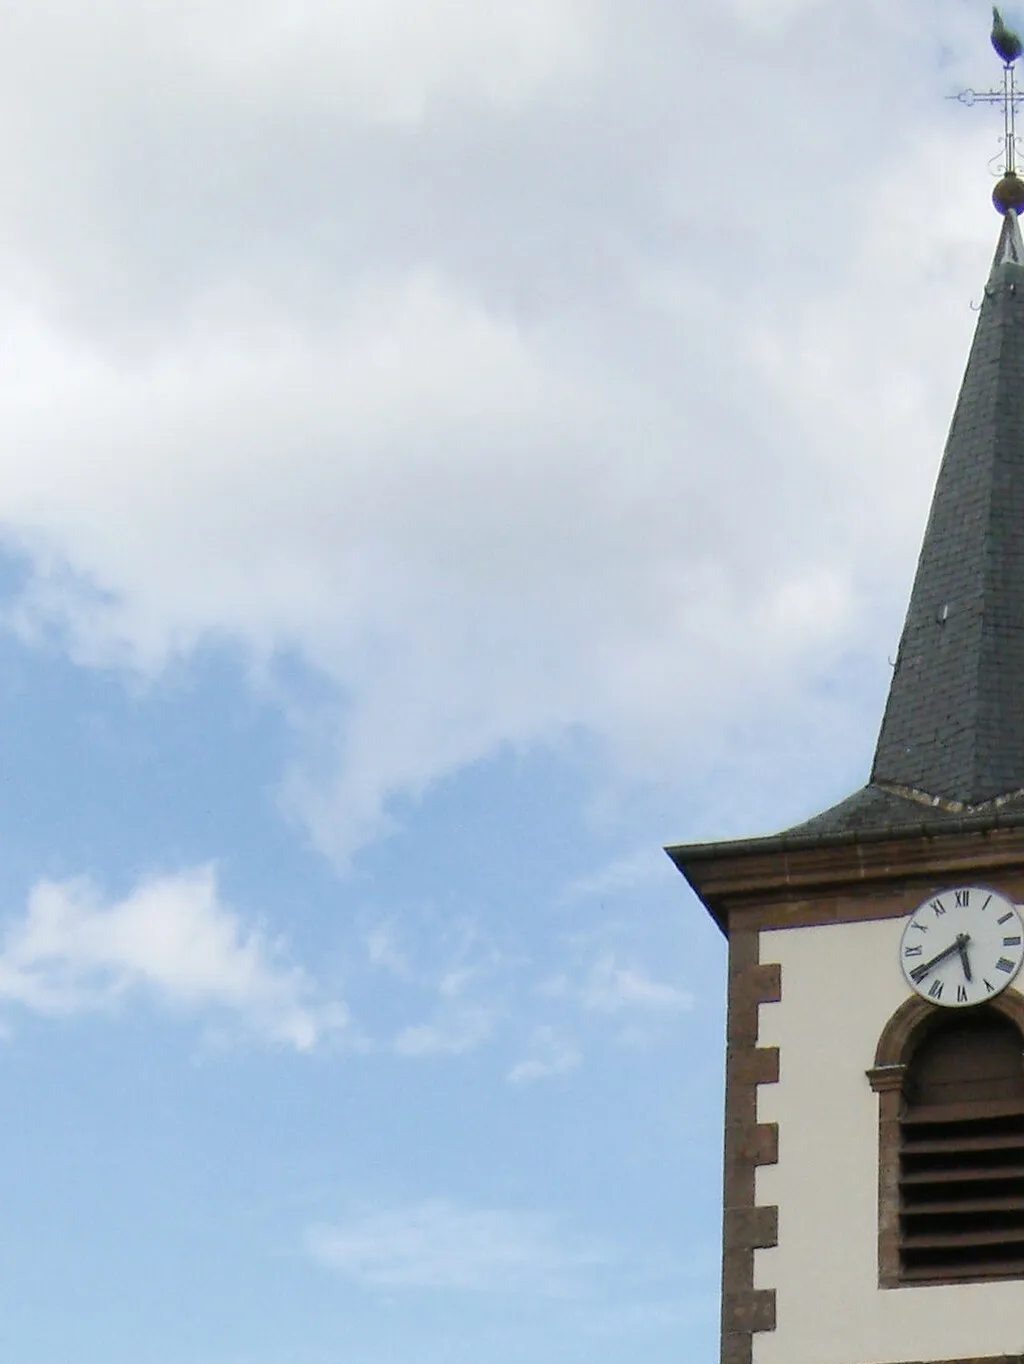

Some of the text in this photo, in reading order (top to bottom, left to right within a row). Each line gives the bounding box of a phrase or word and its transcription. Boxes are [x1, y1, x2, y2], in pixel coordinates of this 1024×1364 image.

[929, 897, 946, 918] XI
[955, 890, 969, 908] XII
[911, 920, 928, 933] X
